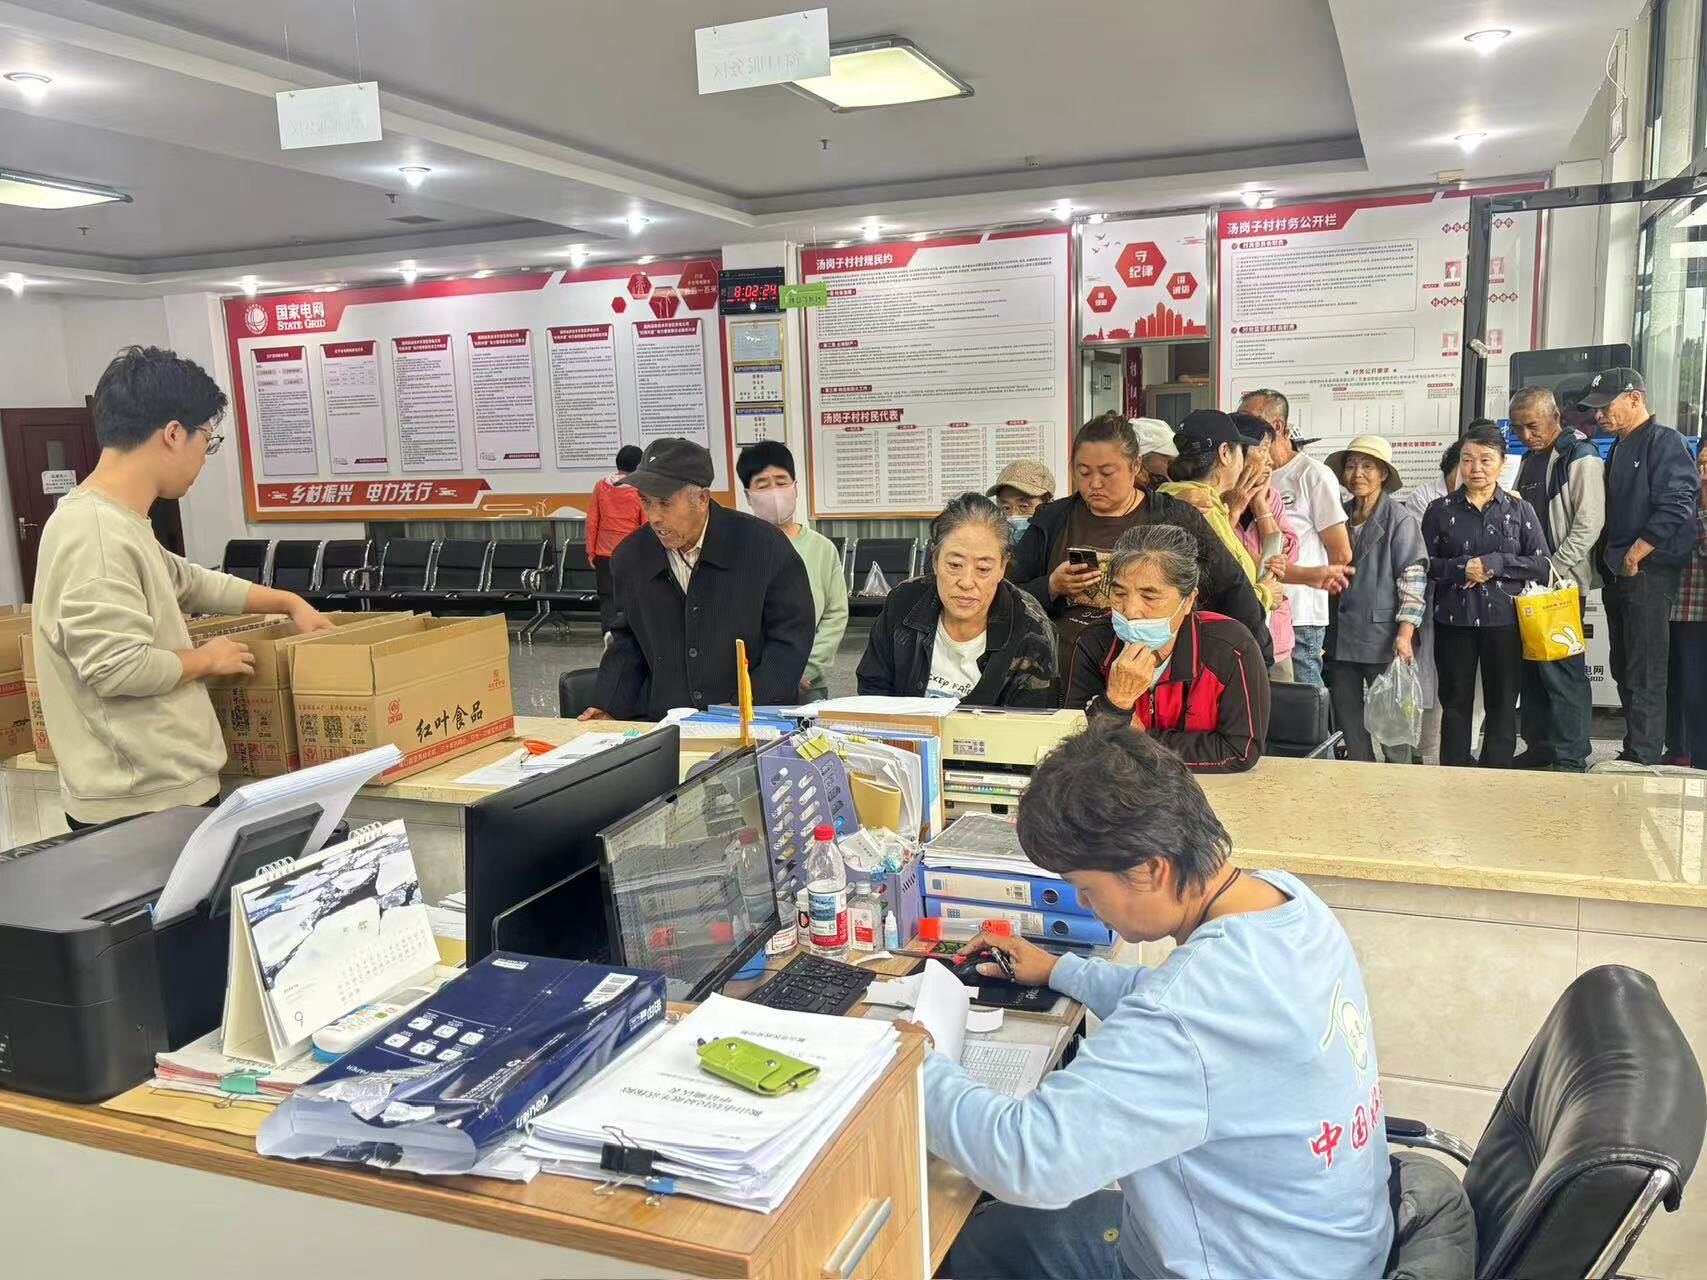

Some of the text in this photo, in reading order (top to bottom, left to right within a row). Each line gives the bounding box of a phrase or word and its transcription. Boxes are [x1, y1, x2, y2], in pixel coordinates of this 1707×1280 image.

[1227, 213, 1337, 235] 汤岗子村村务公开栏
[816, 254, 893, 271] 汤岗子村村规民约
[1135, 251, 1147, 263] 守
[1129, 265, 1154, 278] 纪律
[734, 284, 777, 298] 8:02:24
[276, 301, 324, 320] 国家电网
[277, 319, 326, 331] STATE GRID
[823, 411, 899, 424] 汤岗子村村民代表
[290, 482, 433, 504] 乡村振兴 电力先行
[415, 700, 484, 743] 红叶食品
